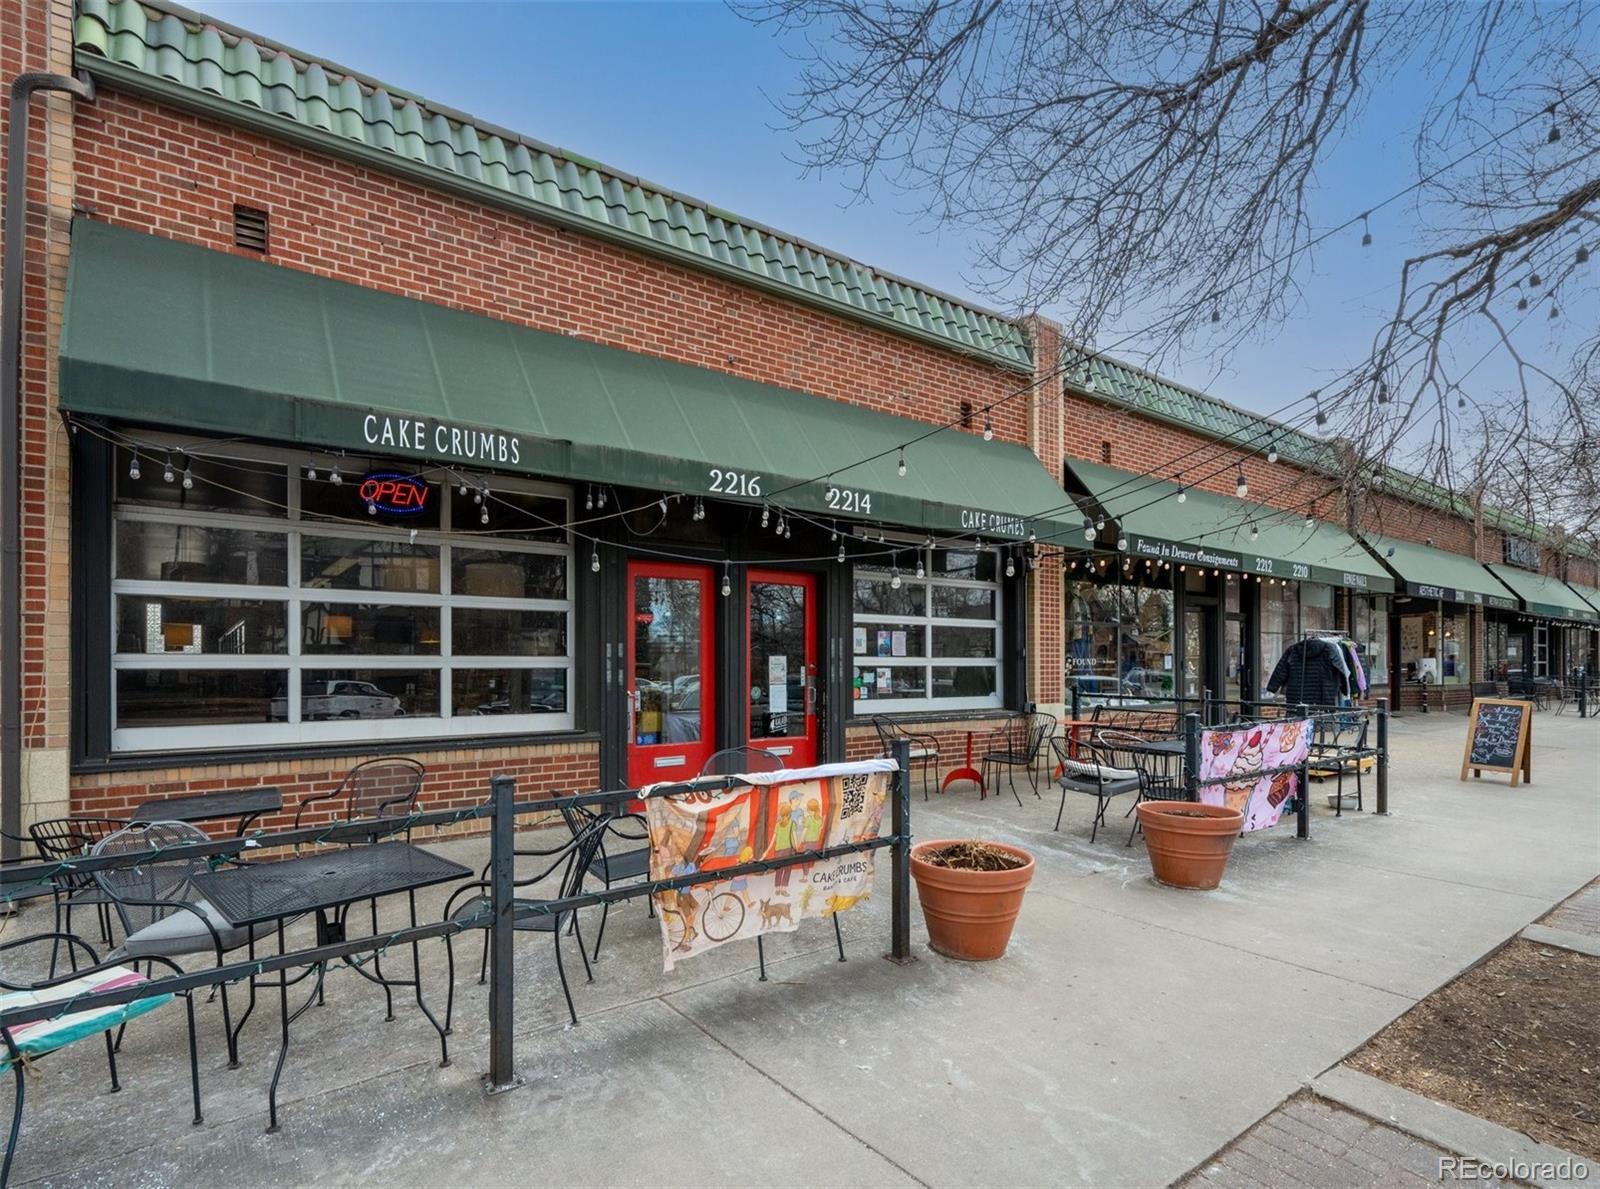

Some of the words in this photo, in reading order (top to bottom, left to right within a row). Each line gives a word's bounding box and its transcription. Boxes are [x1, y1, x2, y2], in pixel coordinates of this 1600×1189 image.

[364, 414, 425, 450] CAKE
[435, 425, 520, 464] CRUMBS
[360, 478, 429, 506] OPEN
[708, 469, 761, 497] 2216
[828, 488, 872, 514] 2214
[961, 510, 987, 530] CAKE
[989, 514, 1025, 536] CRUMBS
[1137, 539, 1160, 555] Found
[1171, 545, 1197, 560] Denver
[1255, 557, 1273, 573] 2212
[1292, 564, 1309, 578] 2210
[1072, 657, 1097, 666] FOUND
